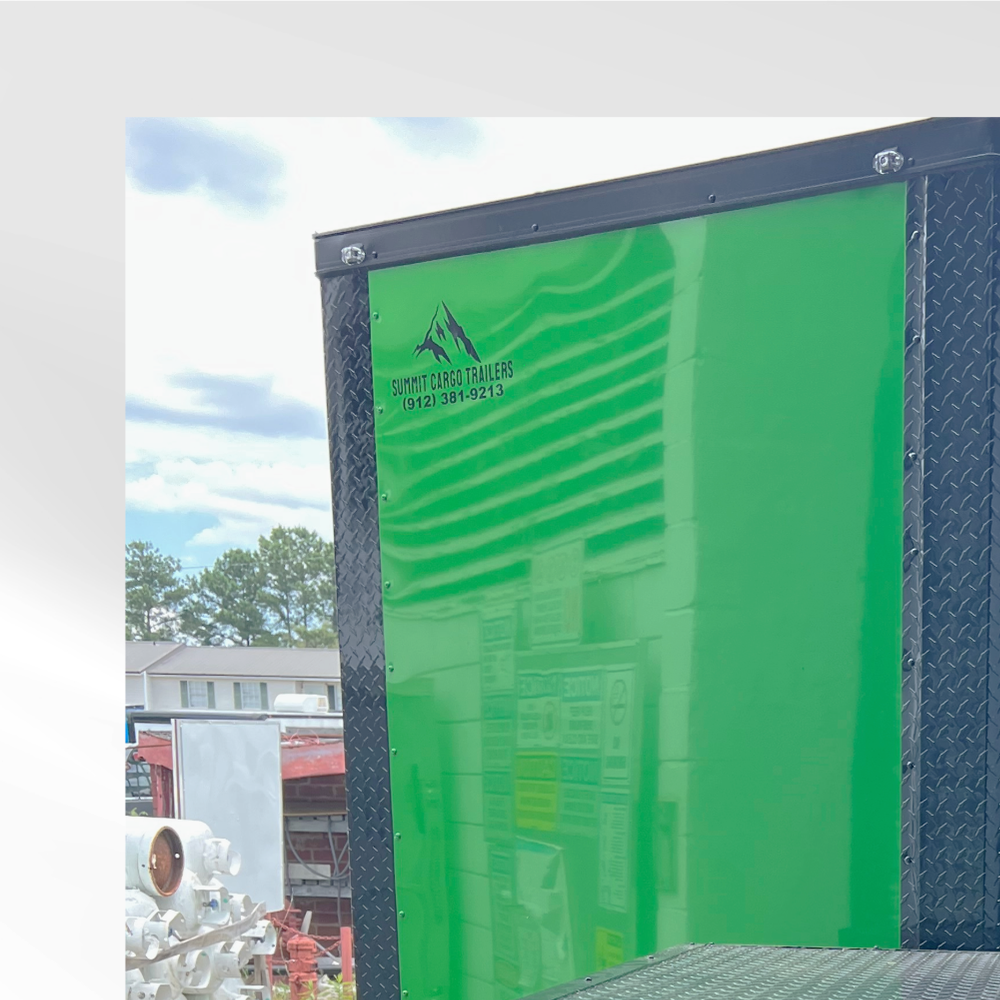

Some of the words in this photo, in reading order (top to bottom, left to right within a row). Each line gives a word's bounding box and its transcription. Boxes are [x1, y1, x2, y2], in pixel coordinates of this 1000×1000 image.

[391, 374, 428, 397] SUMMIT
[430, 369, 463, 391] CARGO
[465, 360, 514, 385] TRAILERS
[402, 394, 436, 411] (912)
[440, 383, 504, 406] 381-9213
